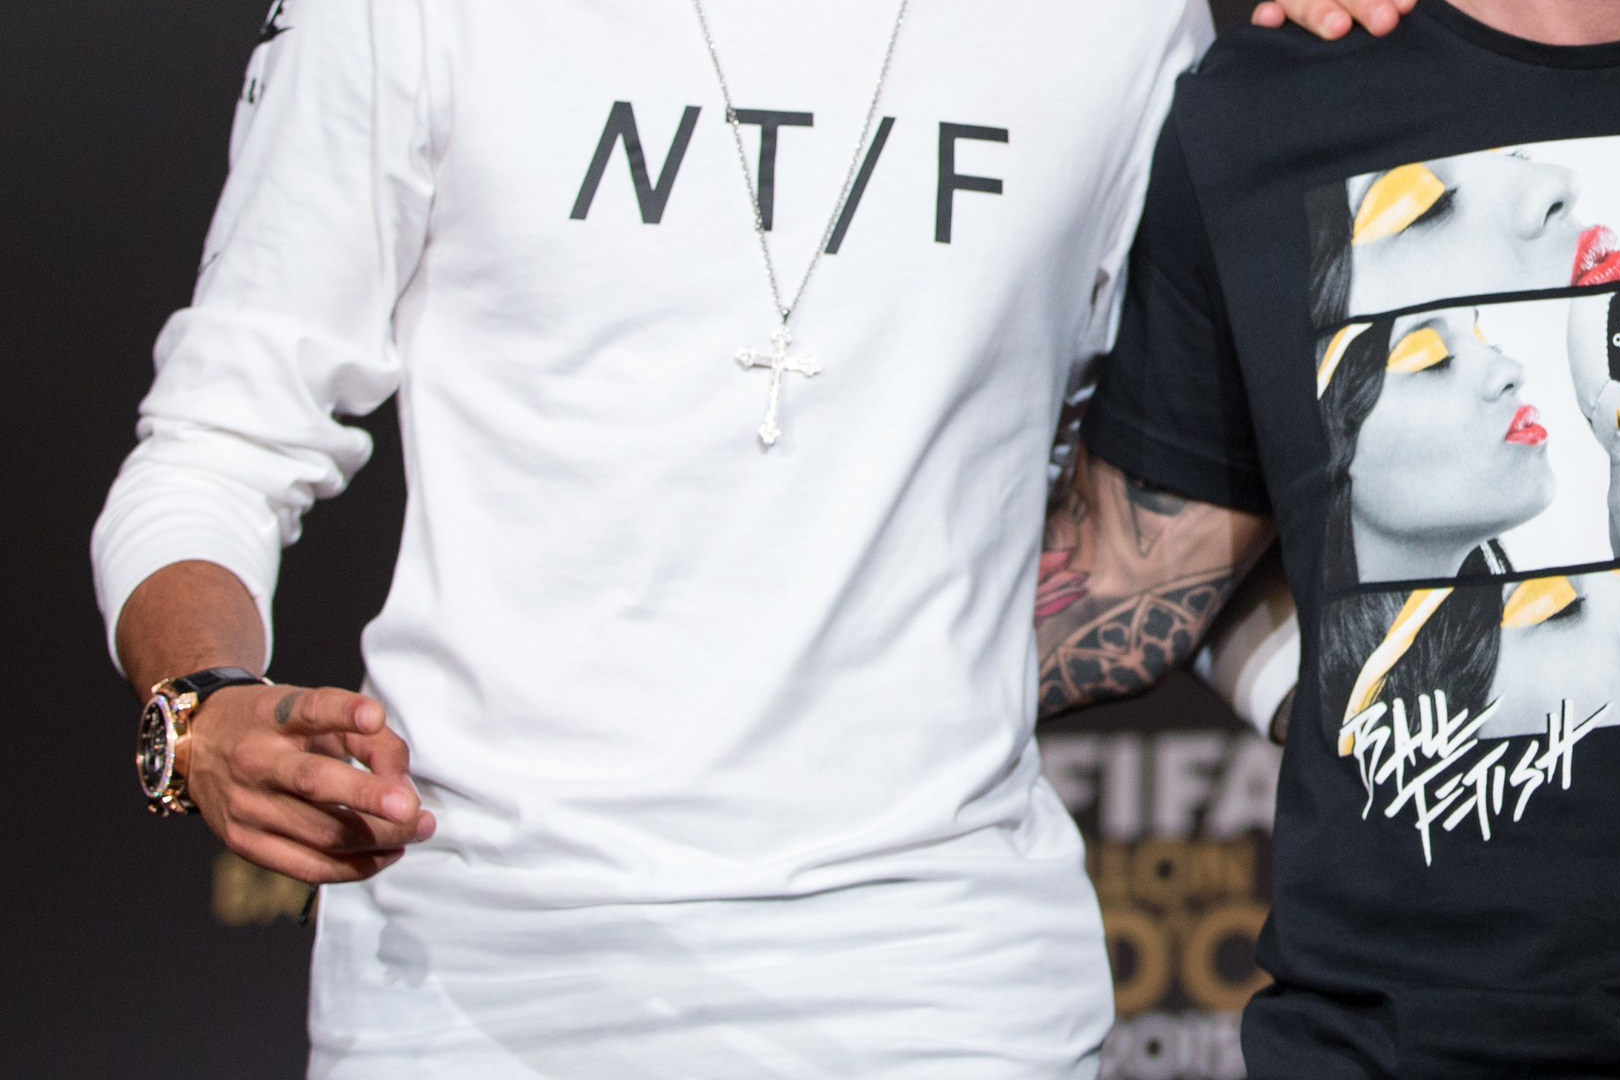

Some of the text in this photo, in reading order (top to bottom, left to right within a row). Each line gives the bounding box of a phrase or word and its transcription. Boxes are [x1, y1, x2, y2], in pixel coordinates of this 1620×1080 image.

[1037, 730, 1286, 842] FIFA
[1339, 688, 1505, 820] BALL
[1384, 698, 1615, 867] FETISH
